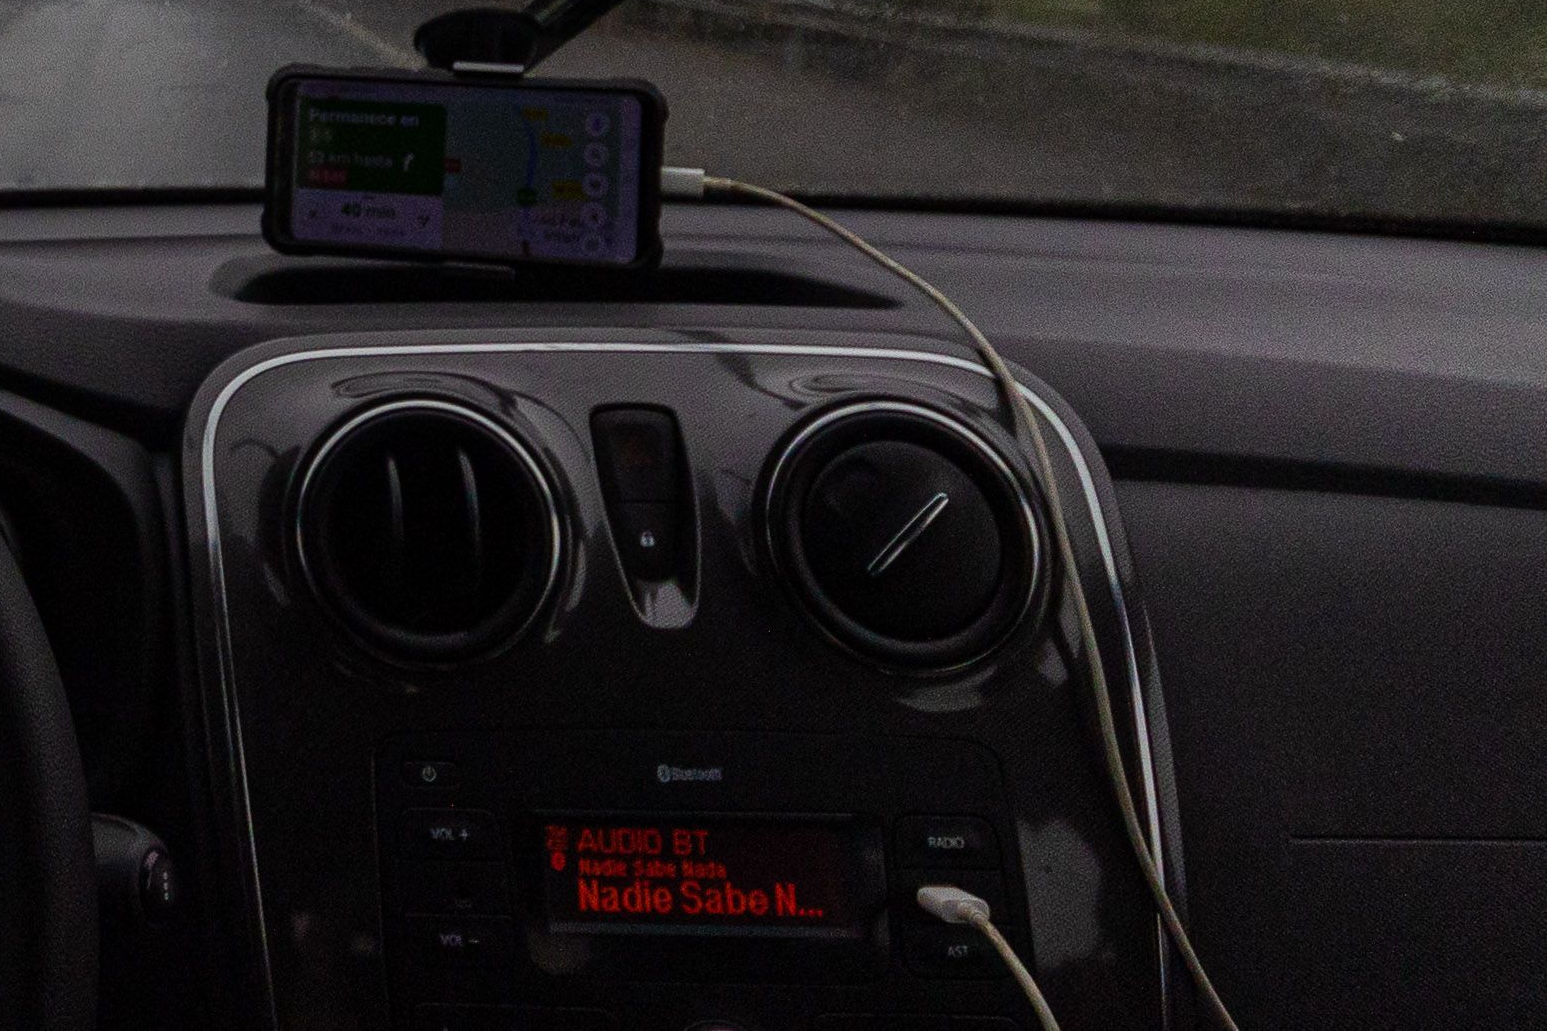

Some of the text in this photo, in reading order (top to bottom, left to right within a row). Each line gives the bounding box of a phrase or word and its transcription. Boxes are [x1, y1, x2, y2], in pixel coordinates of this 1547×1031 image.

[399, 113, 421, 128] en
[430, 827, 455, 841] VOL
[577, 827, 709, 856] AUDIO BT
[926, 835, 966, 850] RADIO
[578, 858, 727, 879] Nadie Sabe Nada
[577, 877, 673, 914] Nadie
[679, 880, 770, 916] Sabe
[947, 944, 970, 959] AST
